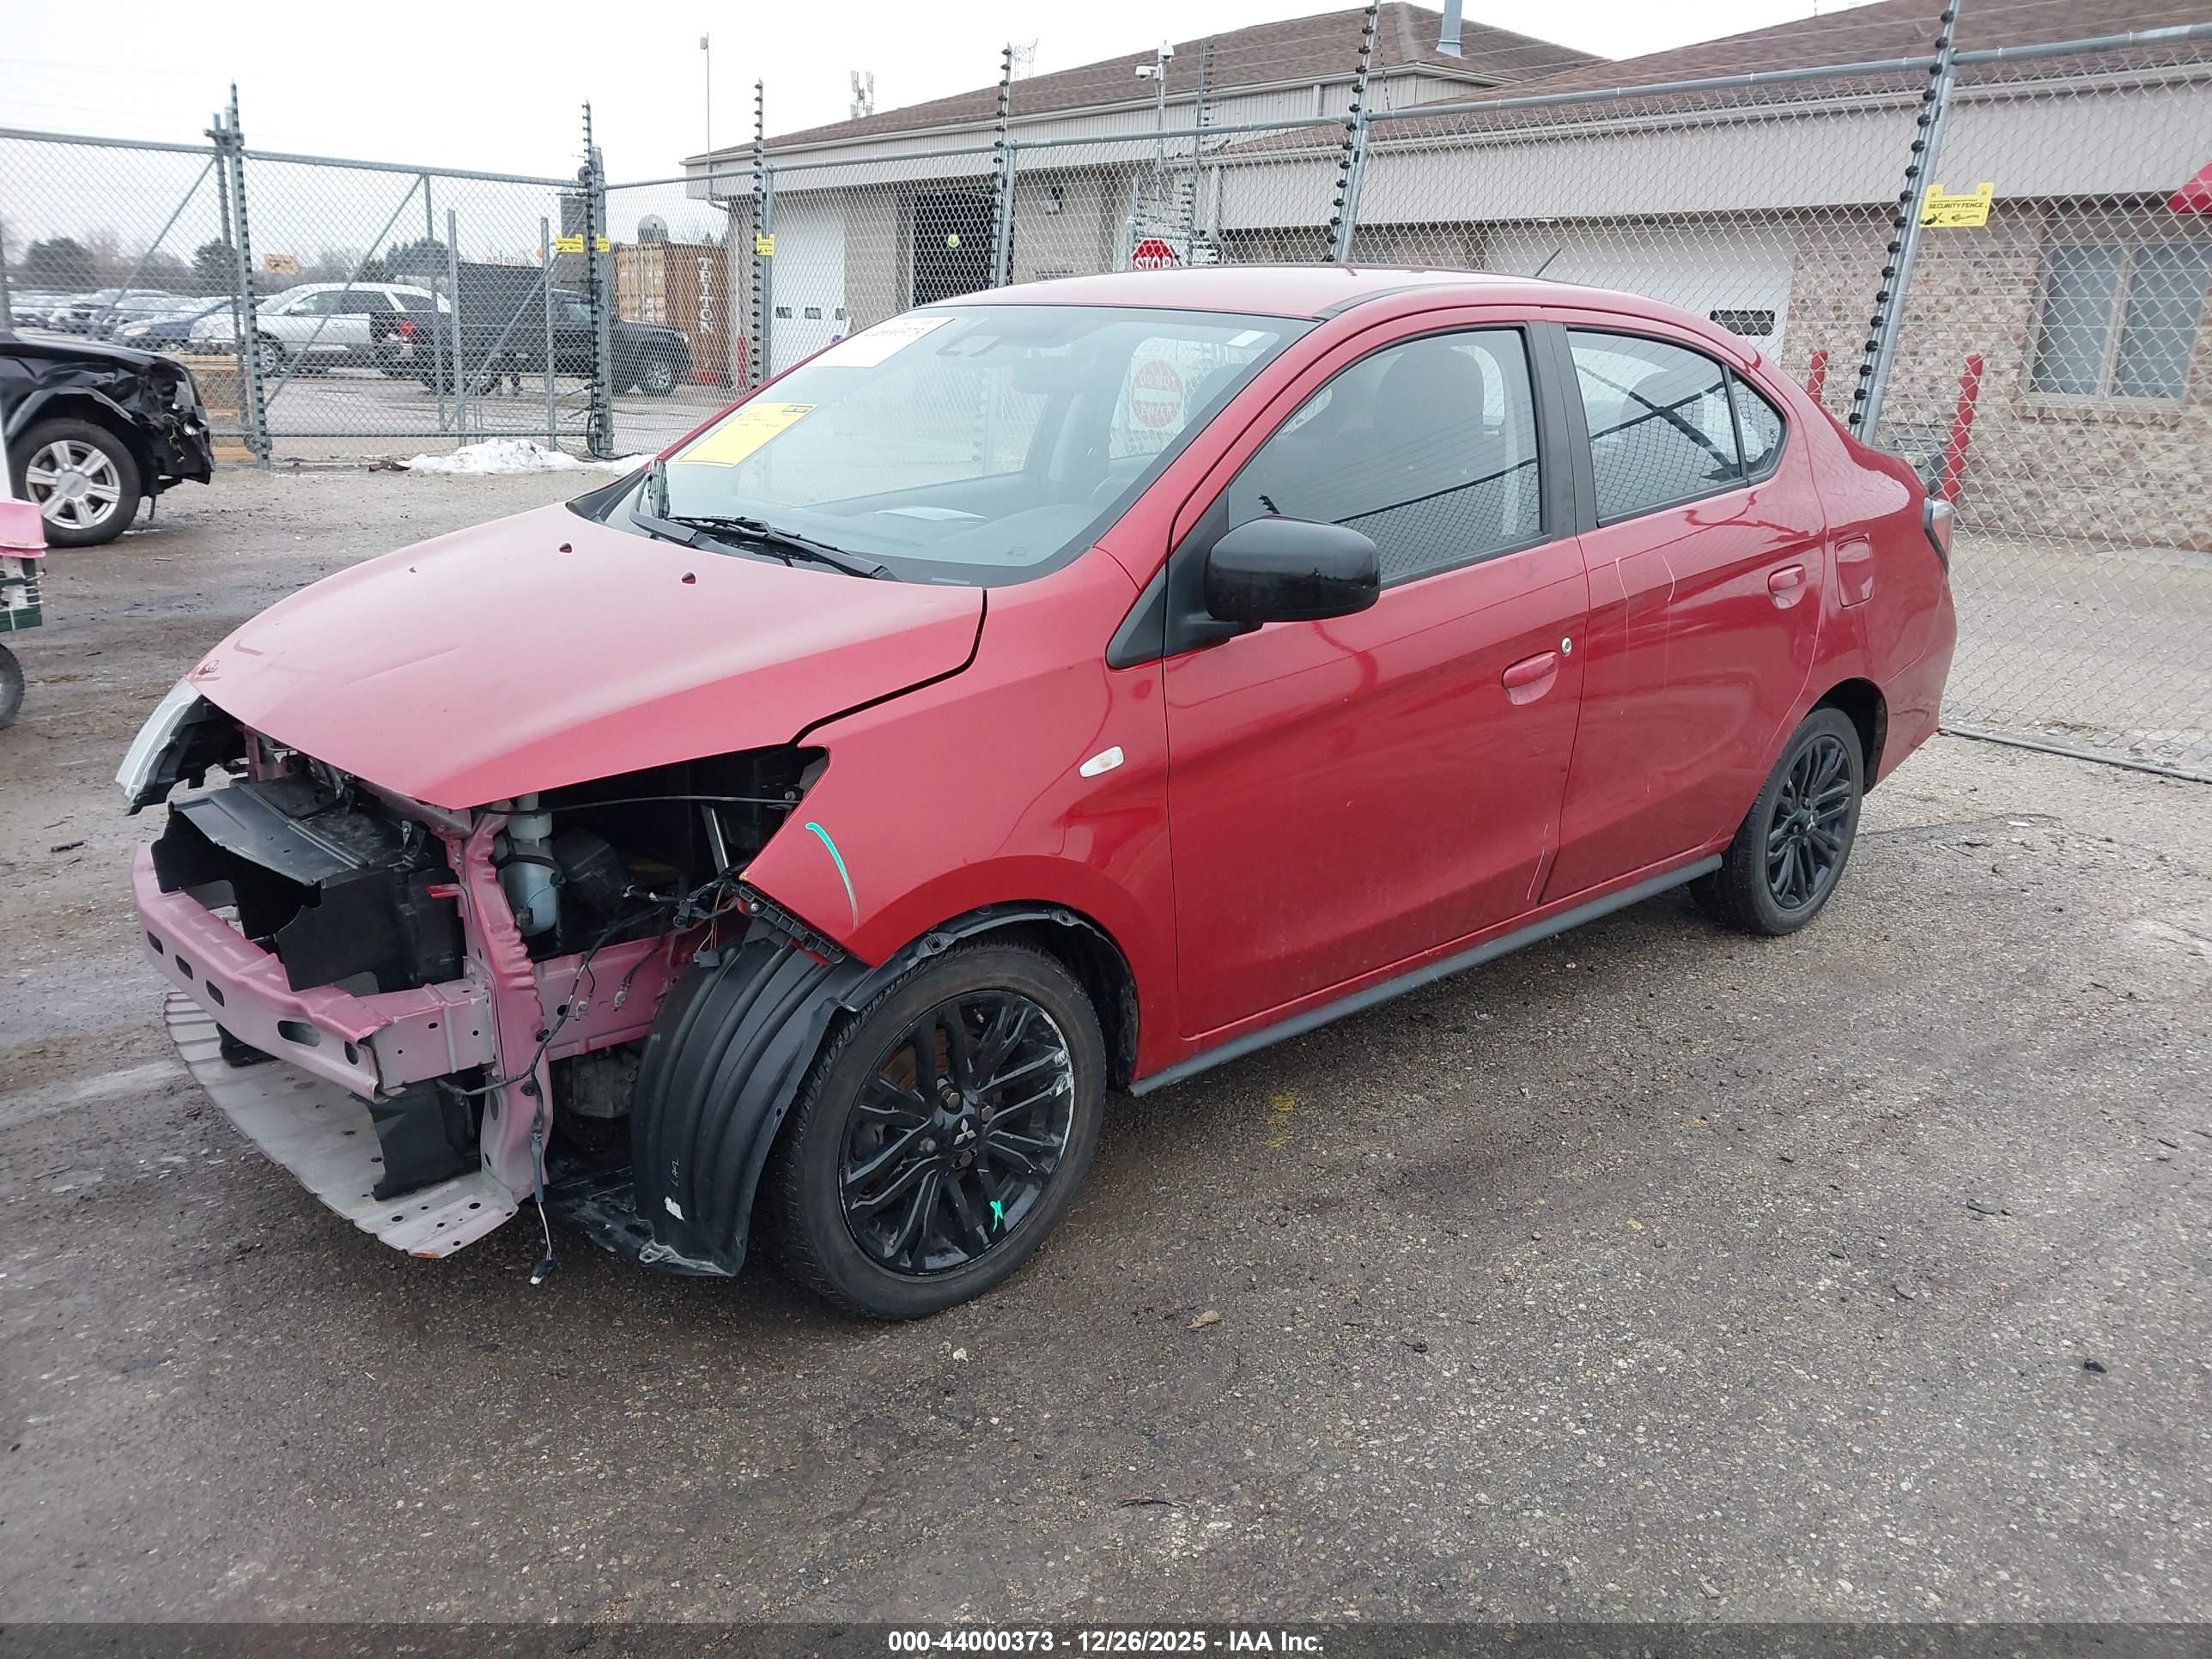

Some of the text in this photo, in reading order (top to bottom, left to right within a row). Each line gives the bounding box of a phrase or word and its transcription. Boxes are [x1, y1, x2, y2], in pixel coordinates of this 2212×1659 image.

[1134, 257, 1172, 269] STOP
[698, 258, 714, 332] TRITON
[1139, 374, 1176, 386] DO NOT
[1140, 404, 1173, 415] ENTER
